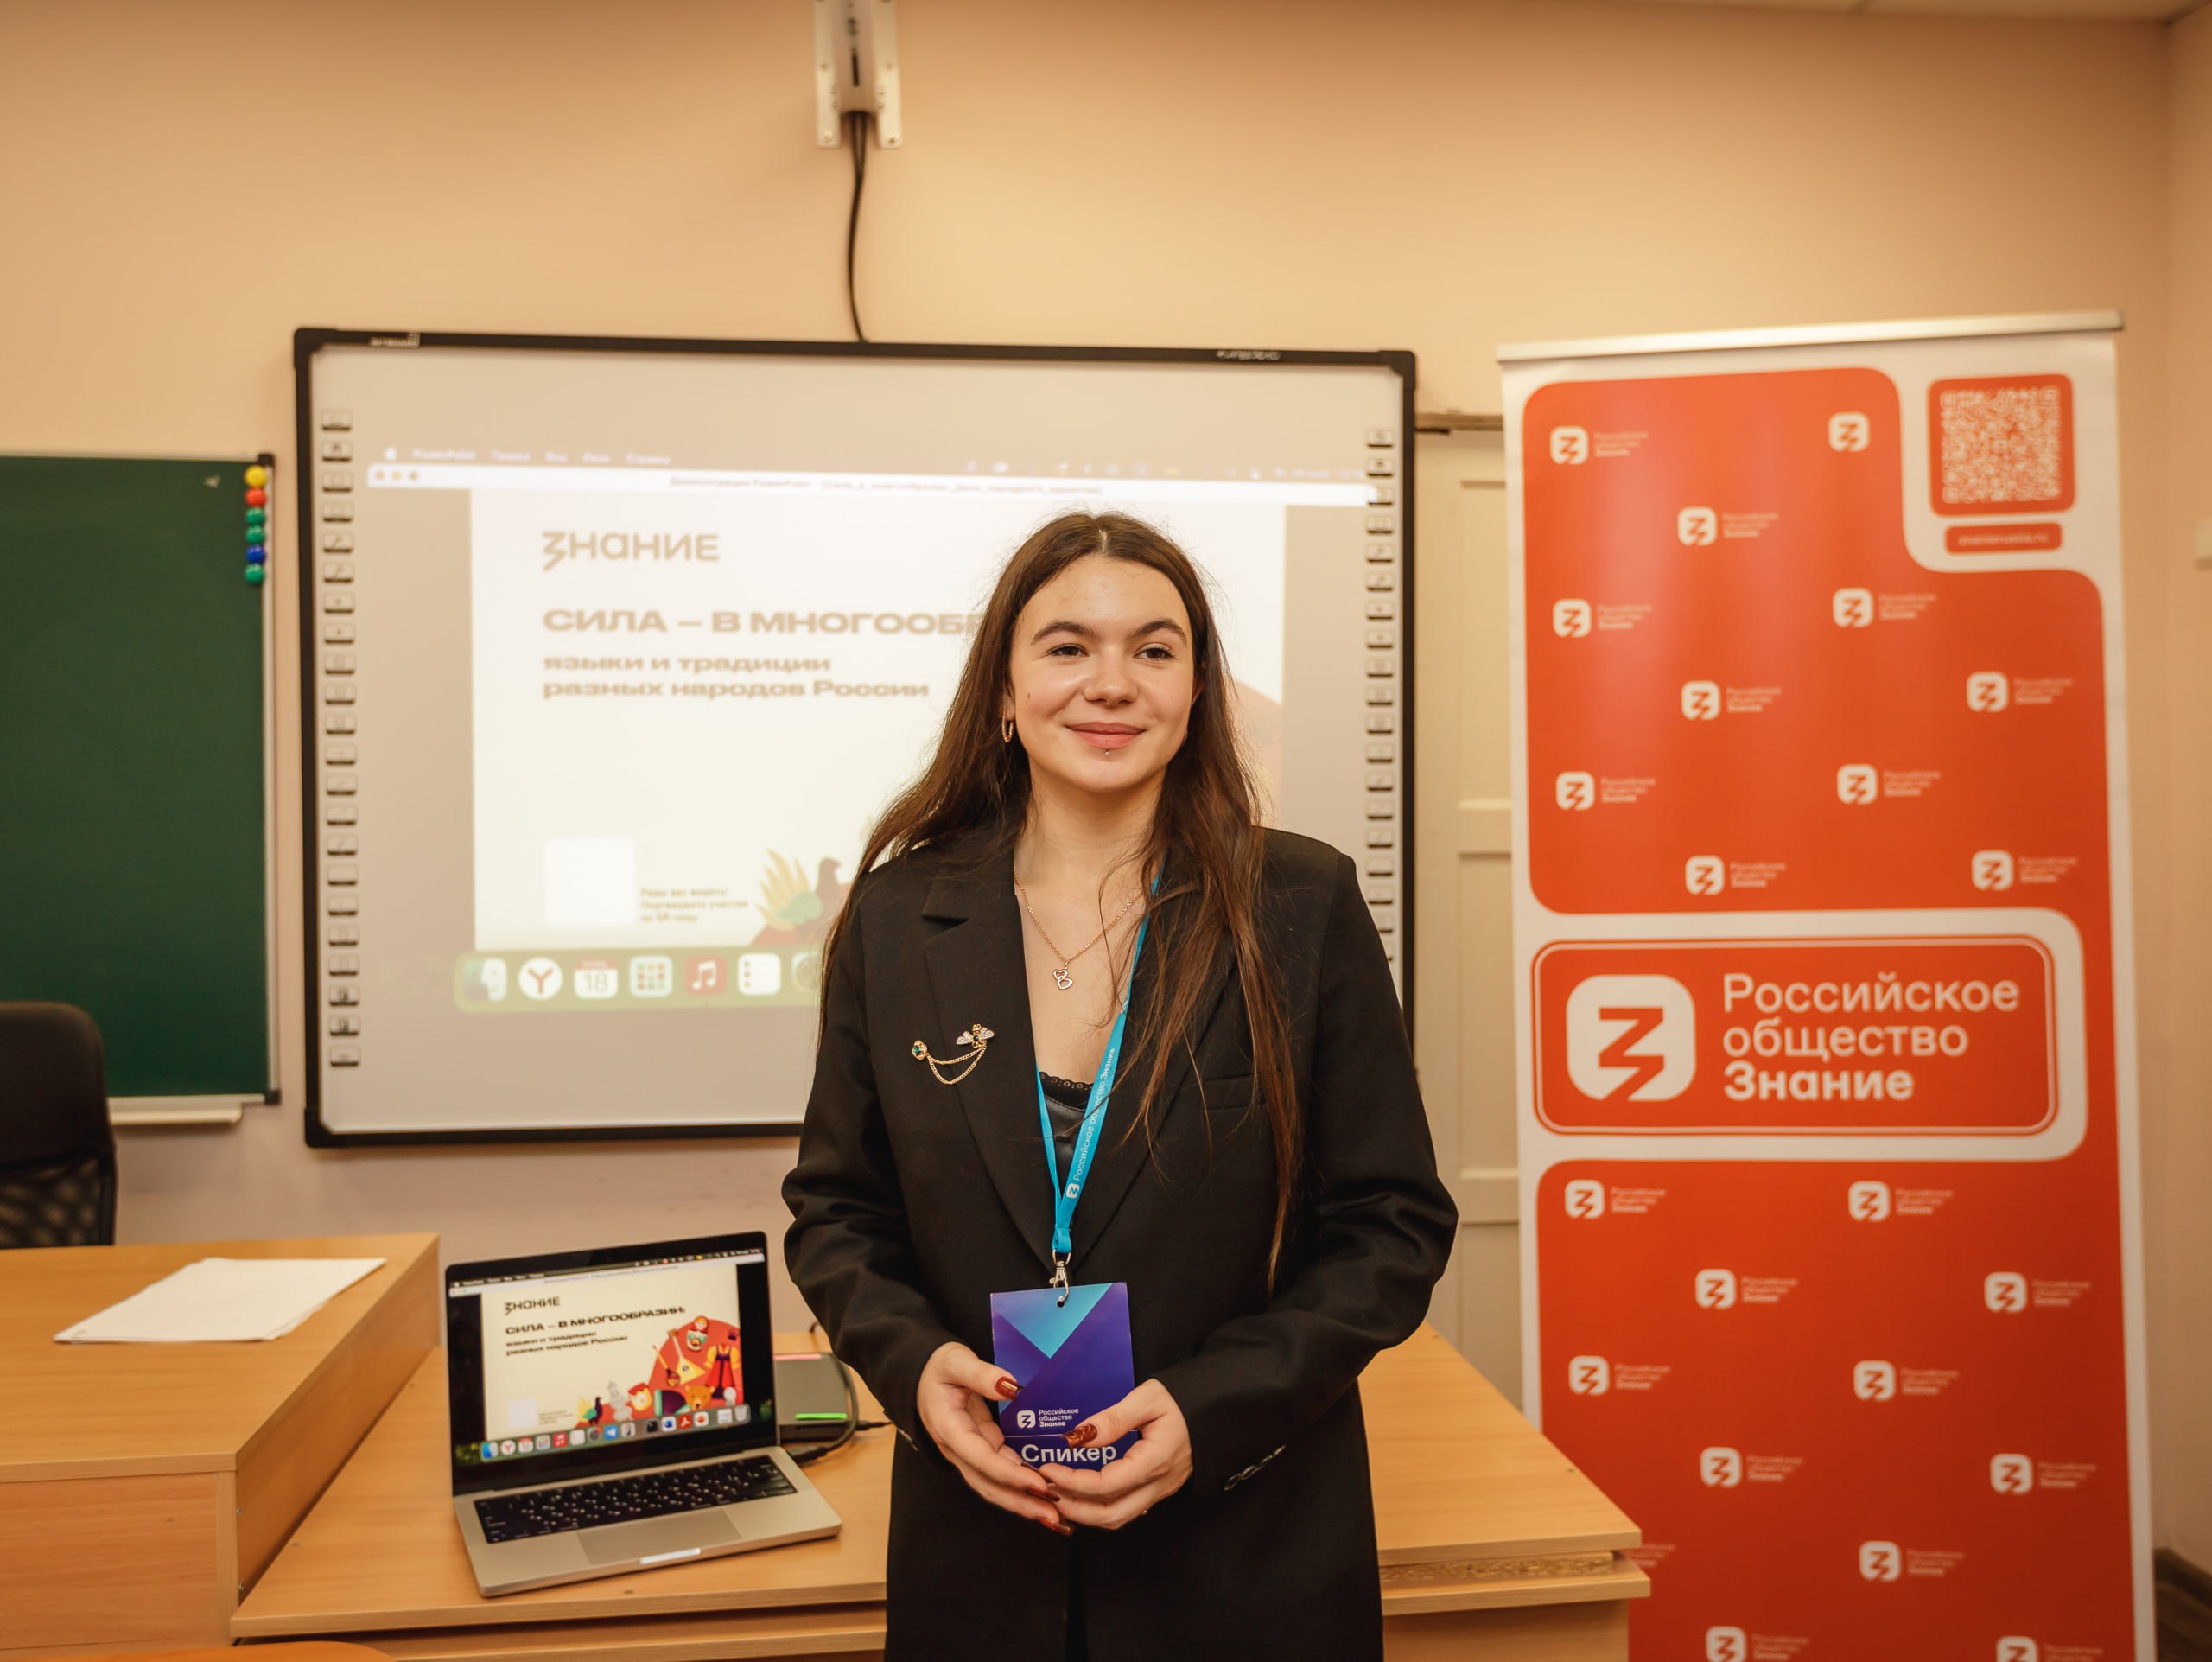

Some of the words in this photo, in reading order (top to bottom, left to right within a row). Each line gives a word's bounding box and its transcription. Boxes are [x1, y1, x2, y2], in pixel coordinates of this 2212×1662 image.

[543, 609, 668, 633] СИЛА
[712, 611, 741, 633] В
[543, 656, 643, 672] языки
[651, 657, 670, 671] и
[678, 657, 831, 674] традиции
[543, 681, 664, 700] разных
[671, 682, 805, 701] народов
[812, 680, 929, 697] России
[1723, 971, 2020, 1014] Российское
[1722, 1016, 1968, 1062] общество
[1723, 1061, 1914, 1101] Знание
[1073, 1125, 1095, 1181] Российское
[1100, 1048, 1115, 1079] Знание
[505, 1322, 544, 1335] СИЛА
[1021, 1444, 1116, 1465] Спикер
